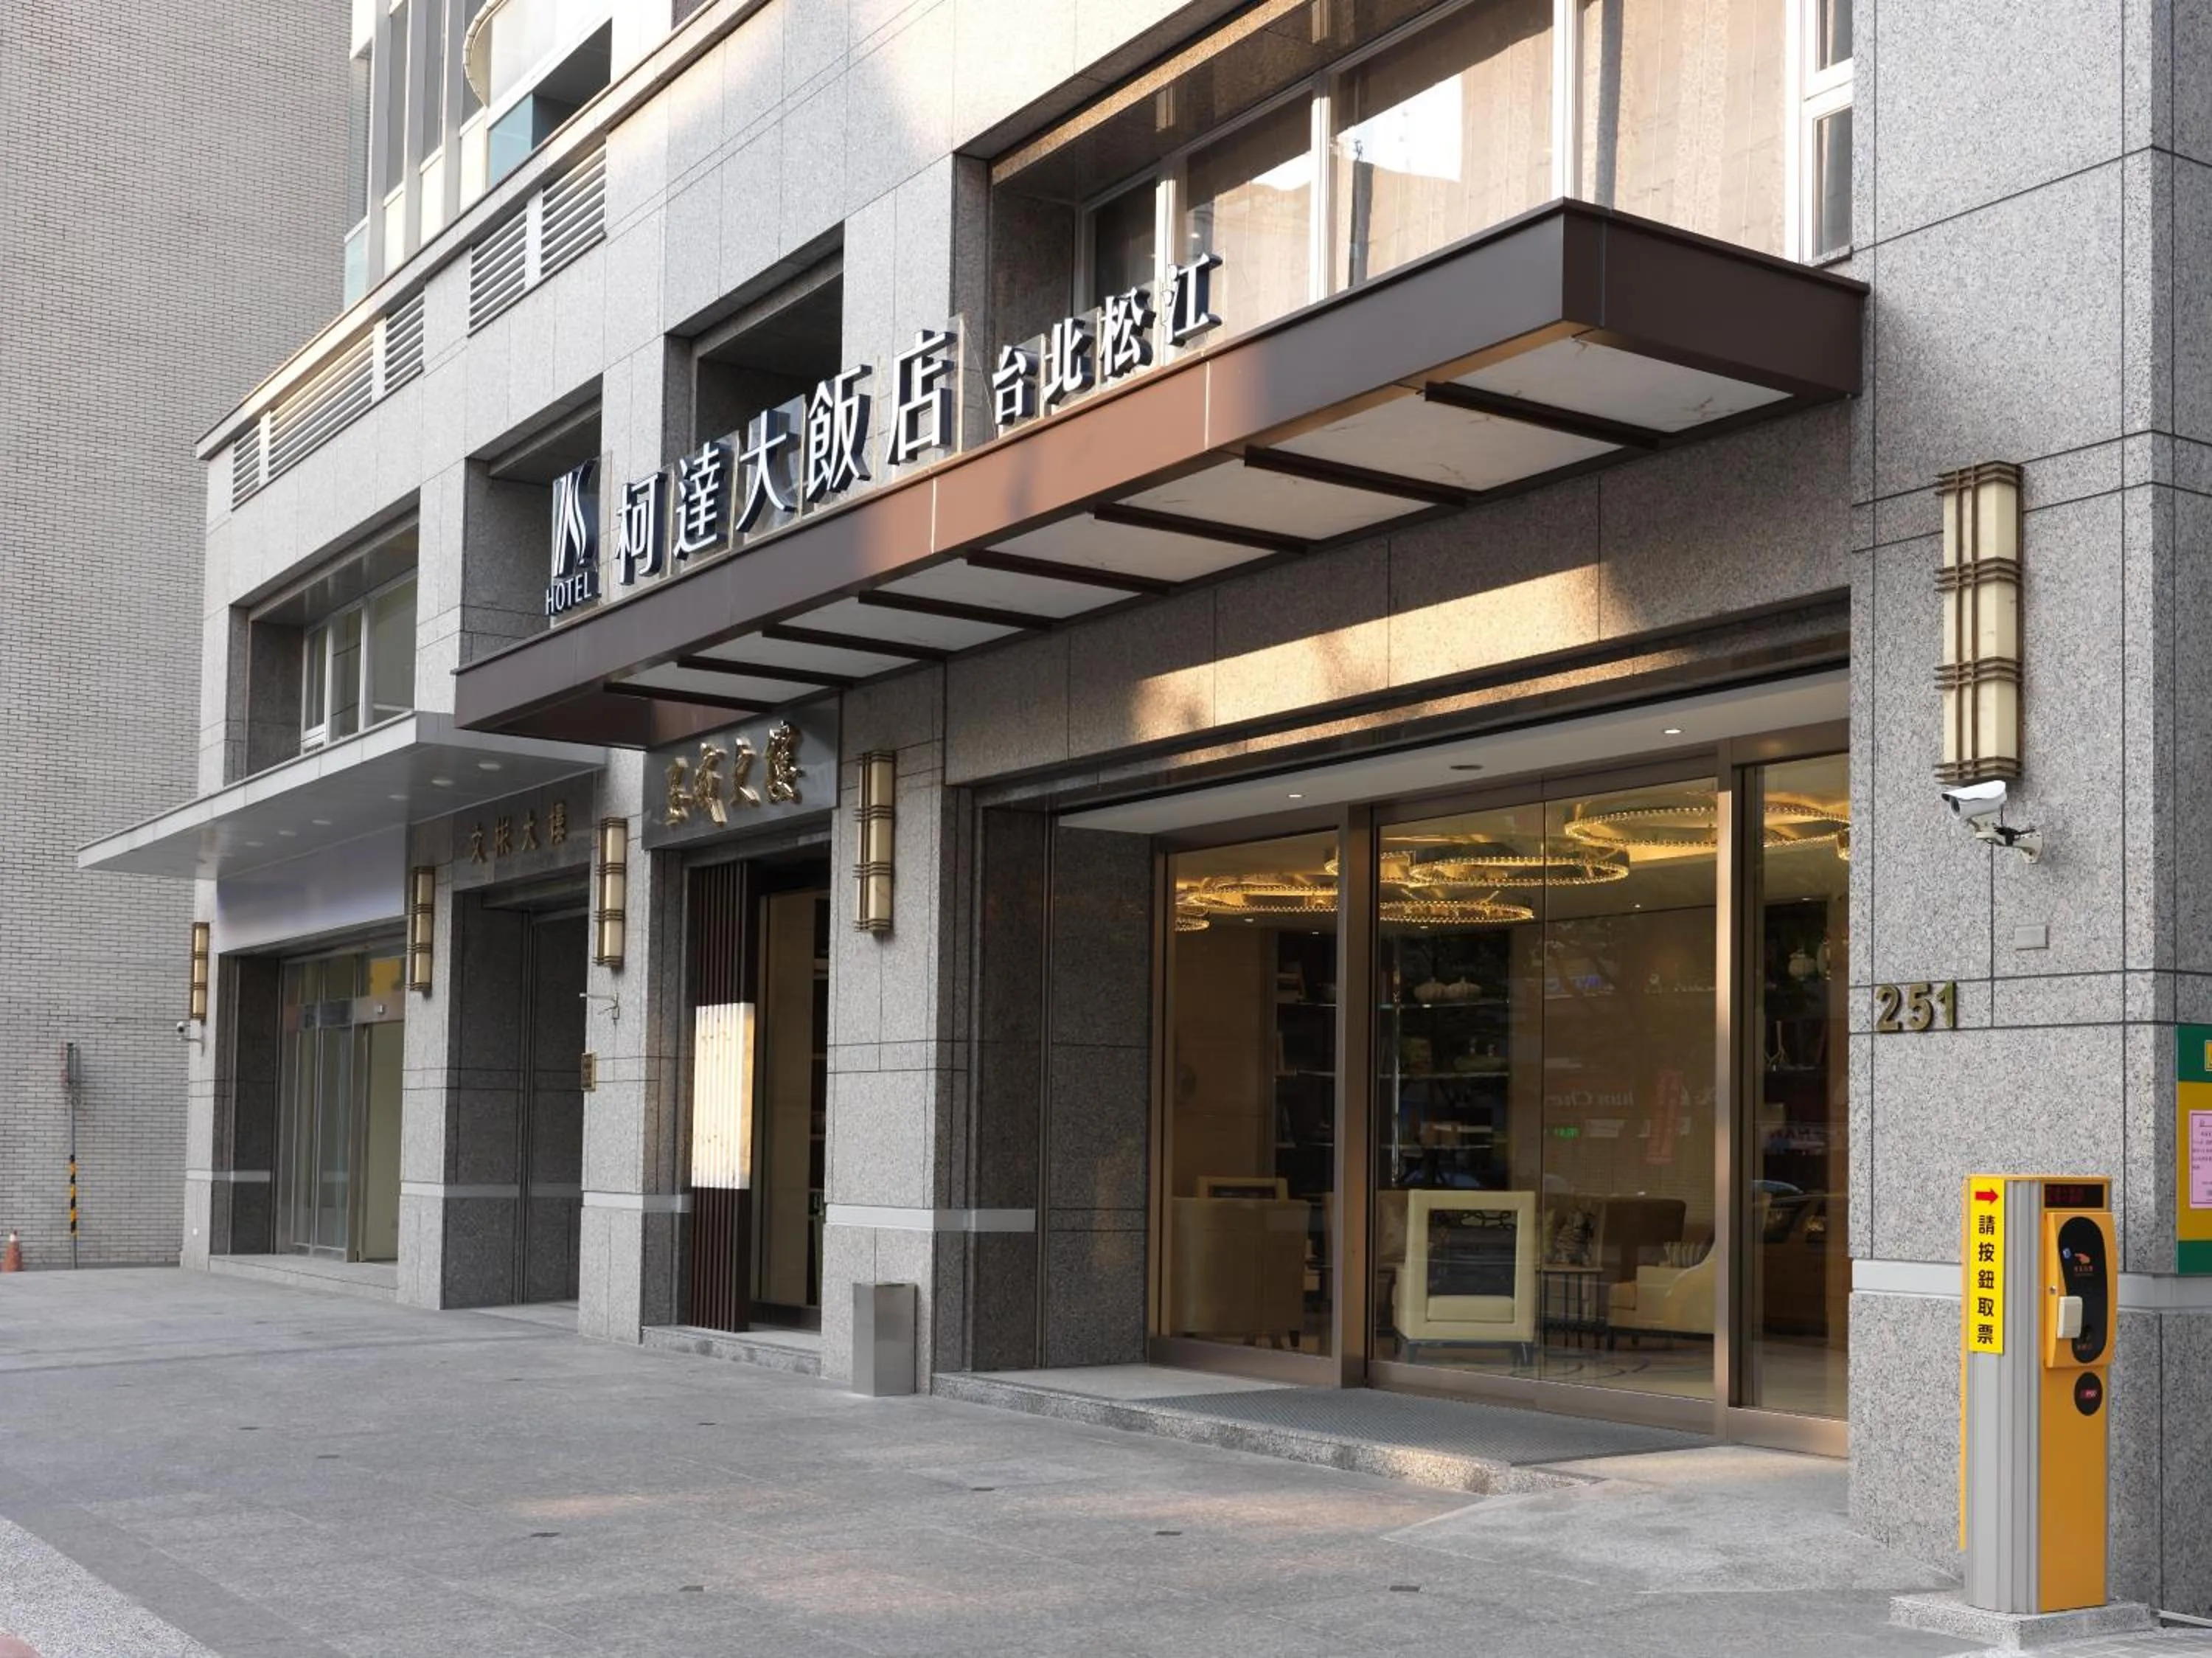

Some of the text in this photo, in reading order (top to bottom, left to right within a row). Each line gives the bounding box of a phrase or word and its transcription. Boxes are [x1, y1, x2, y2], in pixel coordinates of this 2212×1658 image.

[615, 253, 1222, 585] 柯達大飯店 台北松江
[546, 572, 591, 615] HOTEL
[1875, 980, 1957, 1032] 251
[1978, 1215, 1995, 1345] 請按鈕取票
